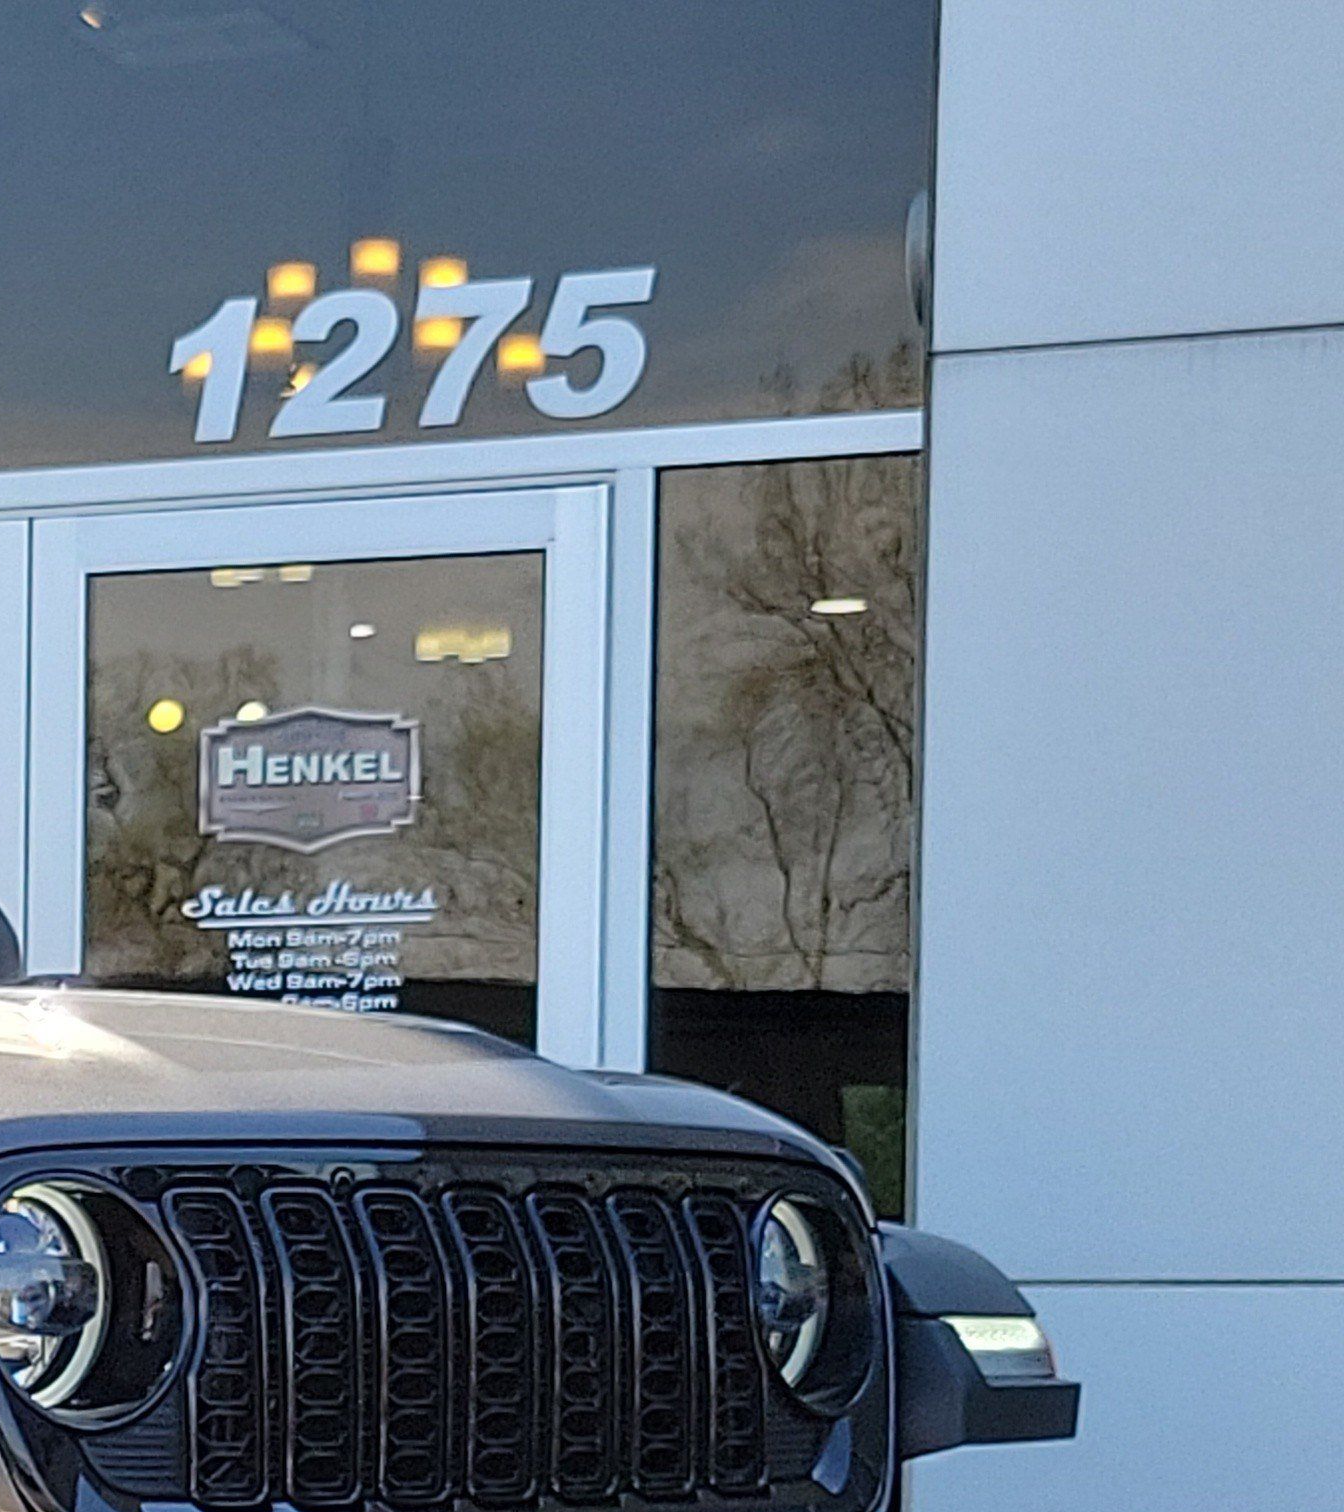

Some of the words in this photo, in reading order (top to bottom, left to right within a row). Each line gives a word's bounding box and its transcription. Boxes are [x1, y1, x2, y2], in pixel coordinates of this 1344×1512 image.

[168, 266, 657, 443] 1275
[180, 884, 297, 919] Sales
[305, 879, 439, 917] Hours
[227, 930, 281, 949] Mon
[229, 951, 273, 970] Tue
[226, 971, 283, 991] Wed
